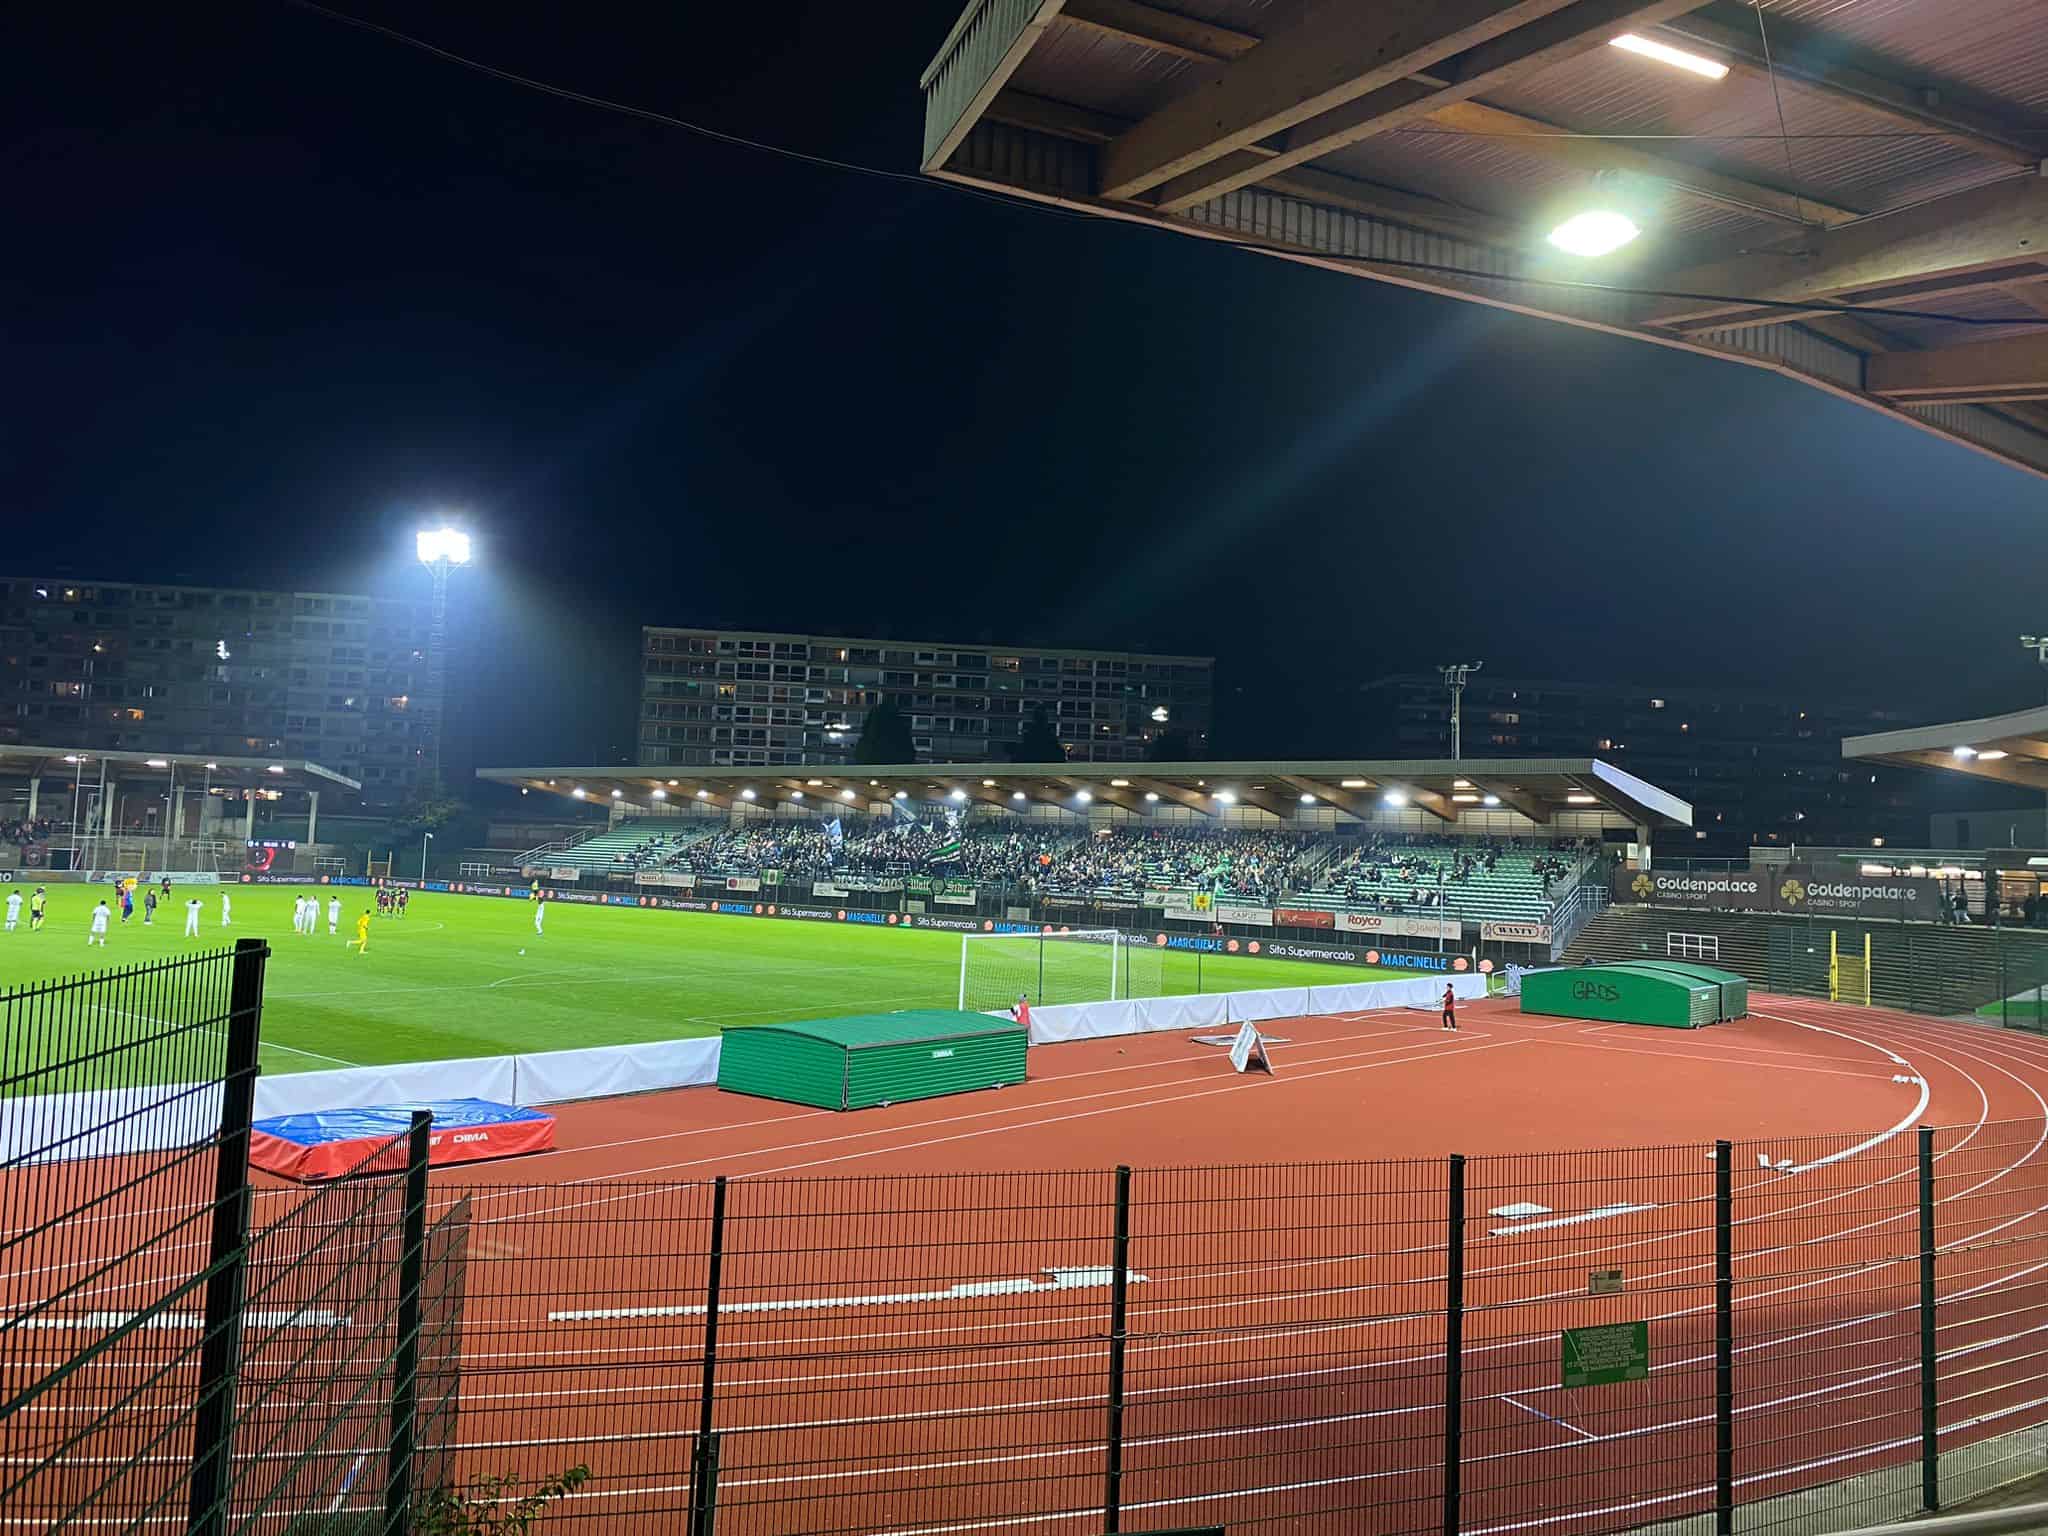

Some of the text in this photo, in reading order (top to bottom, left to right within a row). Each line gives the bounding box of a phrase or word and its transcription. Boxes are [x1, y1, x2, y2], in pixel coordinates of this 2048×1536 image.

[1656, 877, 1758, 893] Goldenpalace
[1807, 883, 1917, 900] Goldenpalace
[1807, 899, 1835, 907] CASINO
[930, 918, 977, 930] Supermercato
[1287, 945, 1356, 961] Supermercato
[1380, 952, 1448, 970] MARCINELLE
[453, 1132, 489, 1144] DIMA
